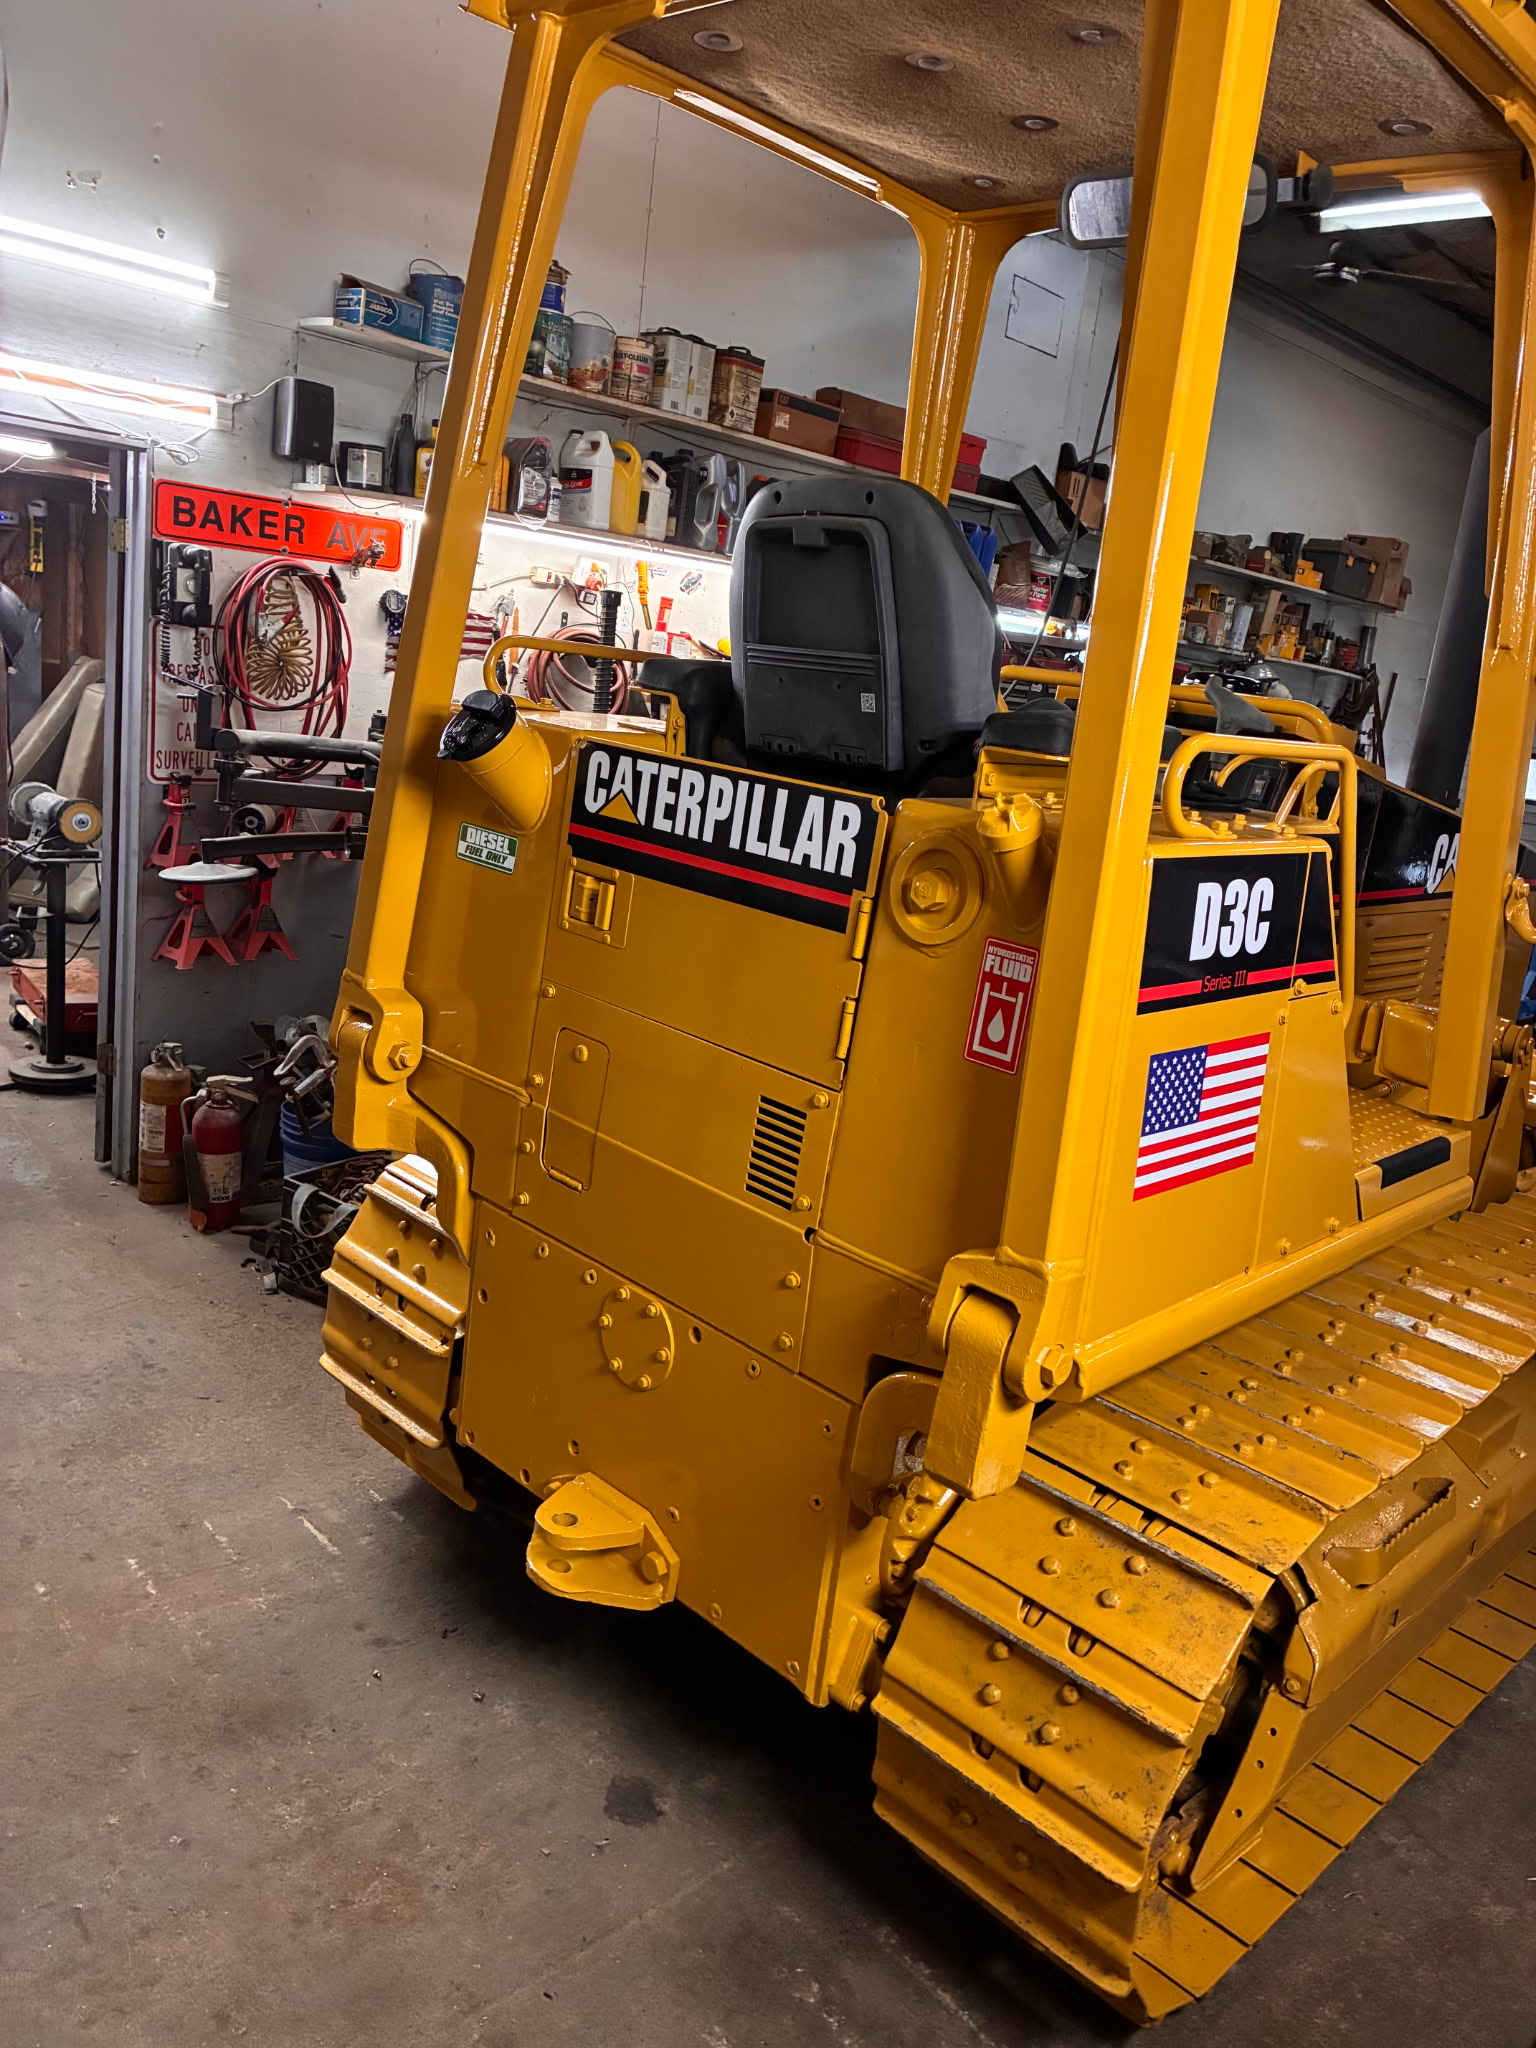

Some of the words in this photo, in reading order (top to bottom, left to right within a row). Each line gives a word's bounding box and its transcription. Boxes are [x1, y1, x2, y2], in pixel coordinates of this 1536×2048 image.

[173, 496, 305, 544] BAKER
[177, 722, 197, 742] CA
[583, 750, 862, 878] CATERPILLAR
[464, 844, 483, 859] FUEL
[485, 851, 508, 865] ONLY
[466, 827, 510, 854] DIESEL
[1427, 833, 1461, 894] CA
[1189, 877, 1274, 962] D3C
[984, 954, 1033, 983] FLUID
[987, 945, 1035, 965] HYDROSTATIC
[1203, 974, 1233, 992] Series
[1233, 970, 1247, 988] III
